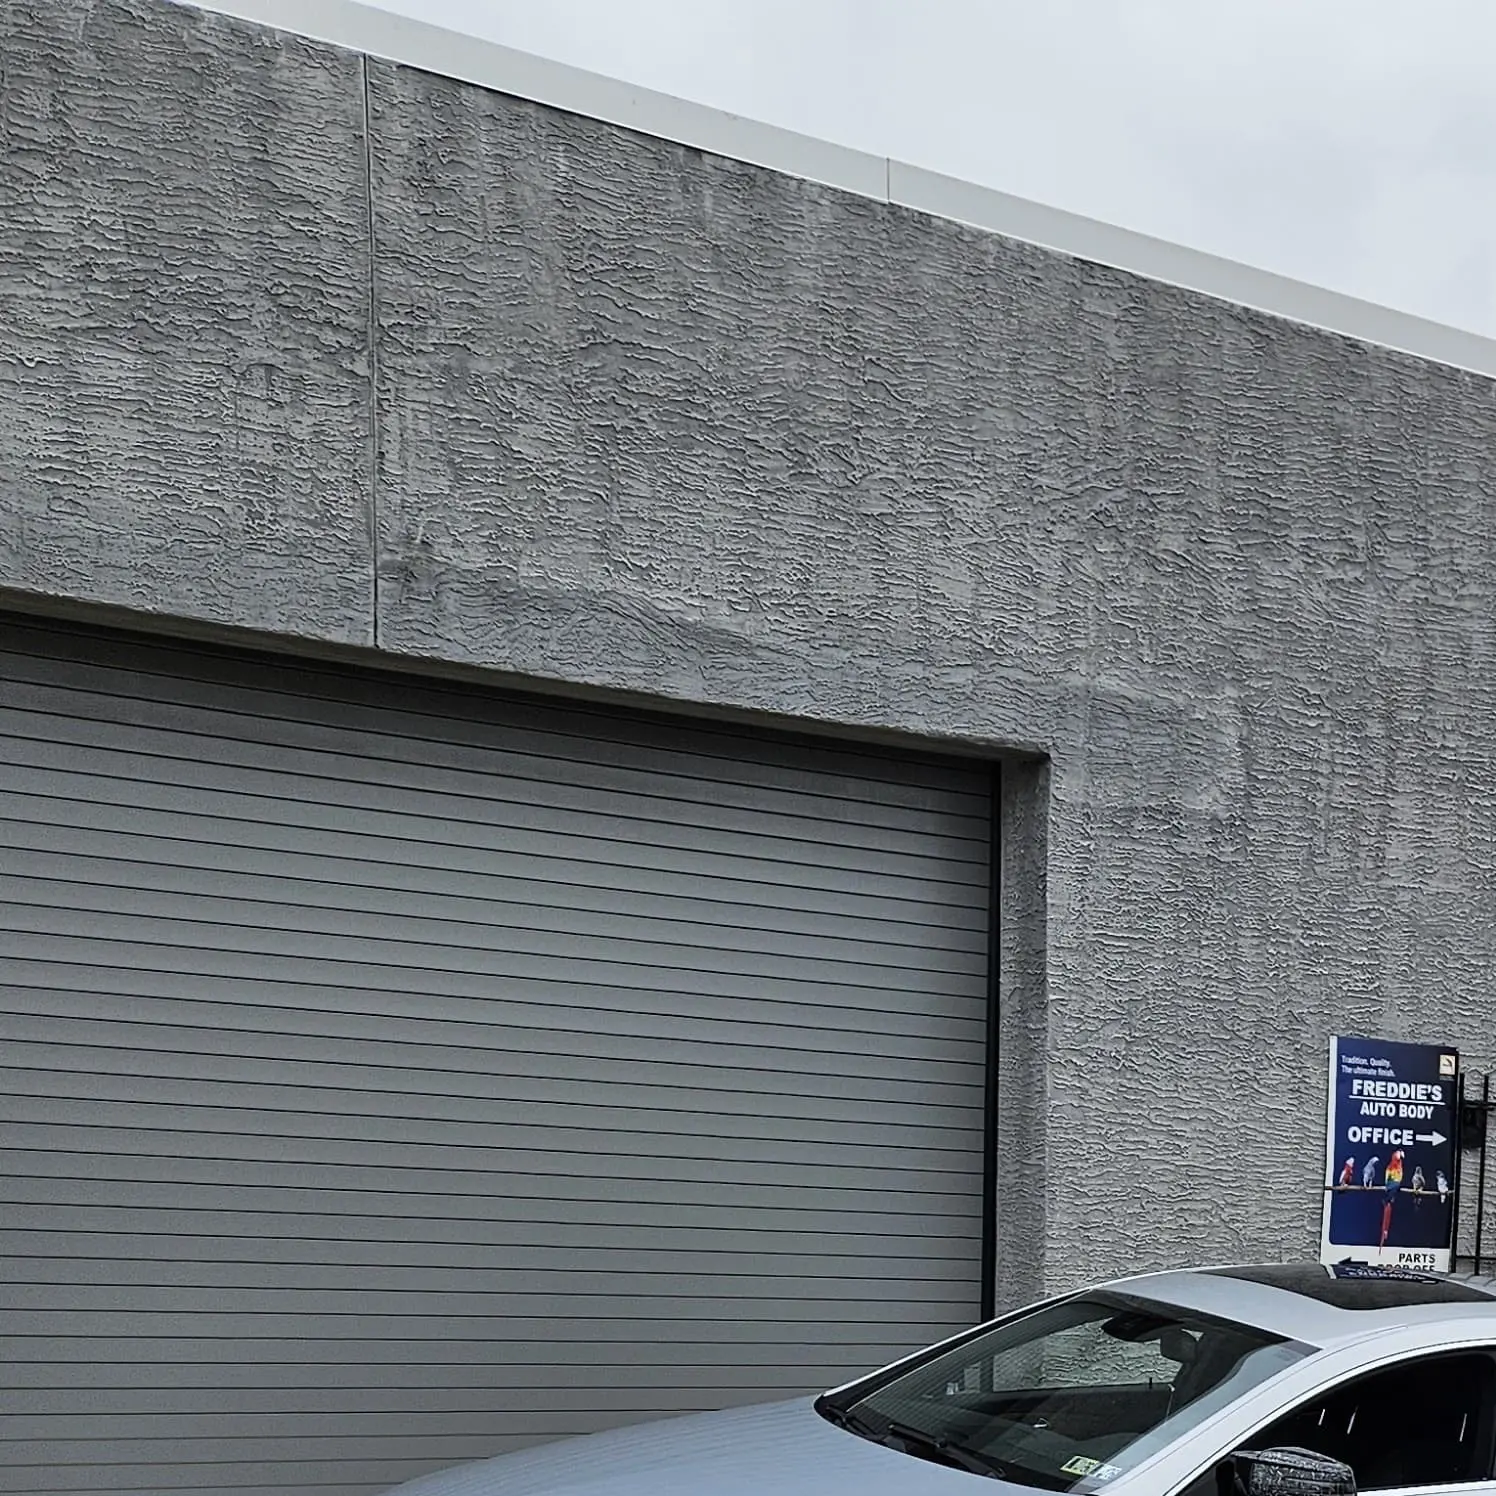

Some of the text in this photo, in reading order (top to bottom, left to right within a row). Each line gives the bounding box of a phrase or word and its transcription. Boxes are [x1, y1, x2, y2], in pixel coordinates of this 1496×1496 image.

[1352, 1079, 1442, 1101] FREDDIE'S
[1360, 1102, 1434, 1120] AUTO BODY
[1347, 1126, 1414, 1146] OFFICE
[1398, 1253, 1436, 1264] PARTS
